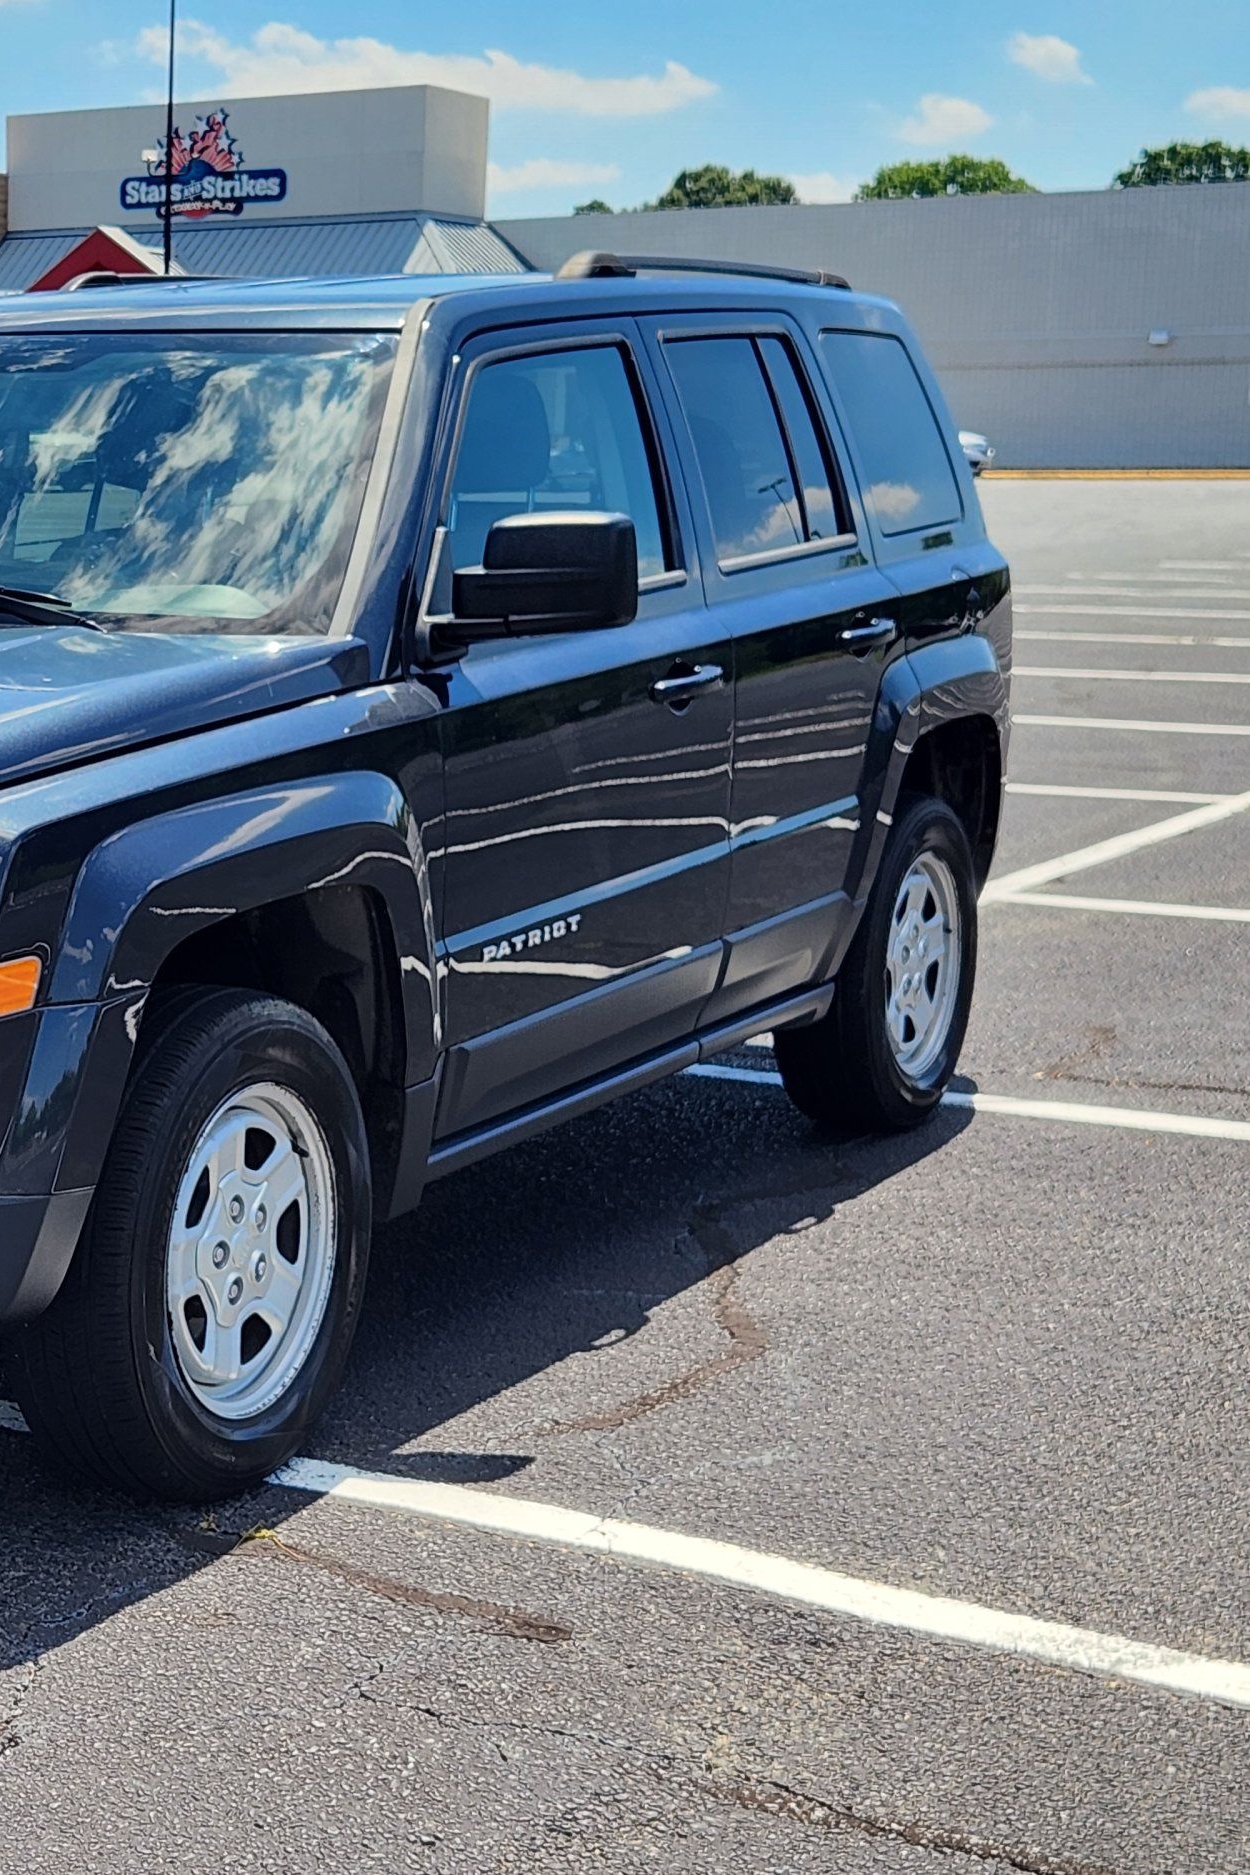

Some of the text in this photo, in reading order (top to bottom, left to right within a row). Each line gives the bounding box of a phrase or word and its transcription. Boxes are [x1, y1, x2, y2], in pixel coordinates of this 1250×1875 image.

[125, 180, 182, 204] Stars
[201, 174, 281, 200] Strikes
[482, 913, 581, 962] PATRIOT
